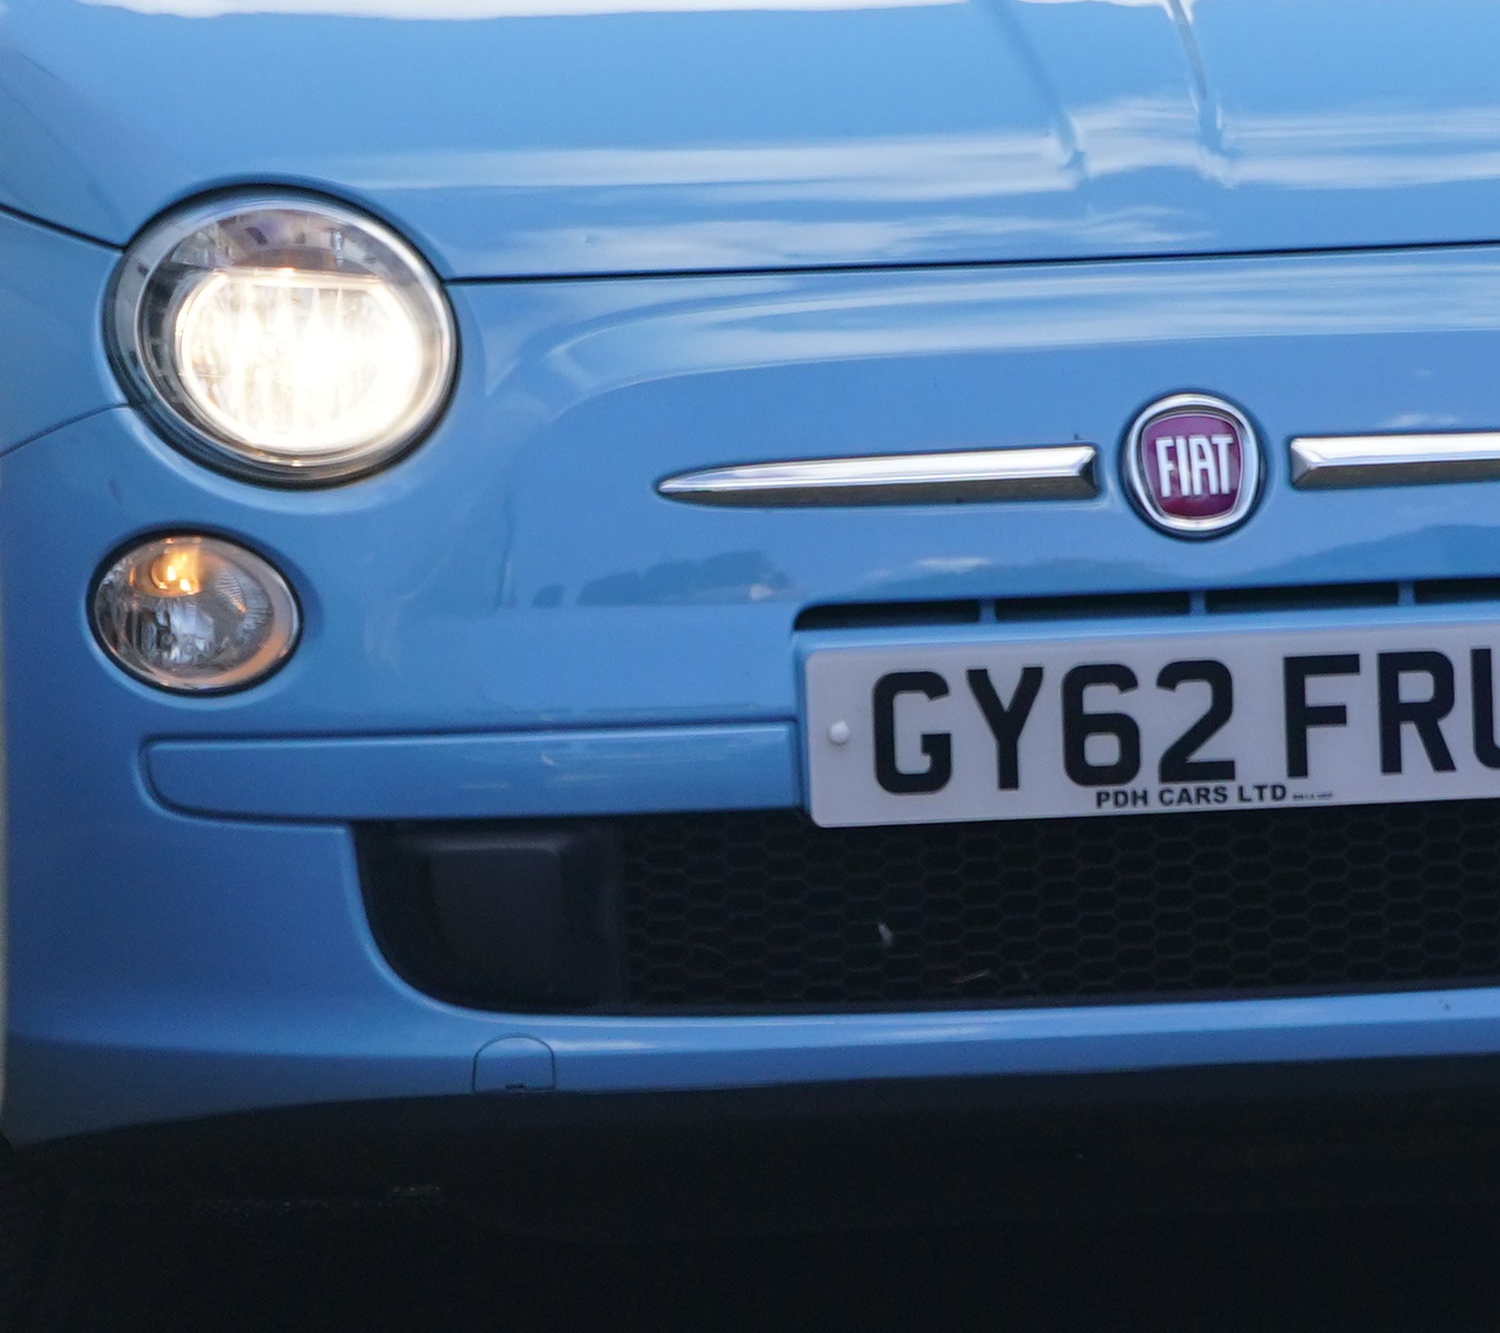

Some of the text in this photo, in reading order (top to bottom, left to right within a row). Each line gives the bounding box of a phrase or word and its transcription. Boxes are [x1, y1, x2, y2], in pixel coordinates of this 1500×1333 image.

[1155, 434, 1234, 498] FIAT
[872, 659, 1236, 795] GY62
[1095, 784, 1288, 809] PDH CARS LTD
